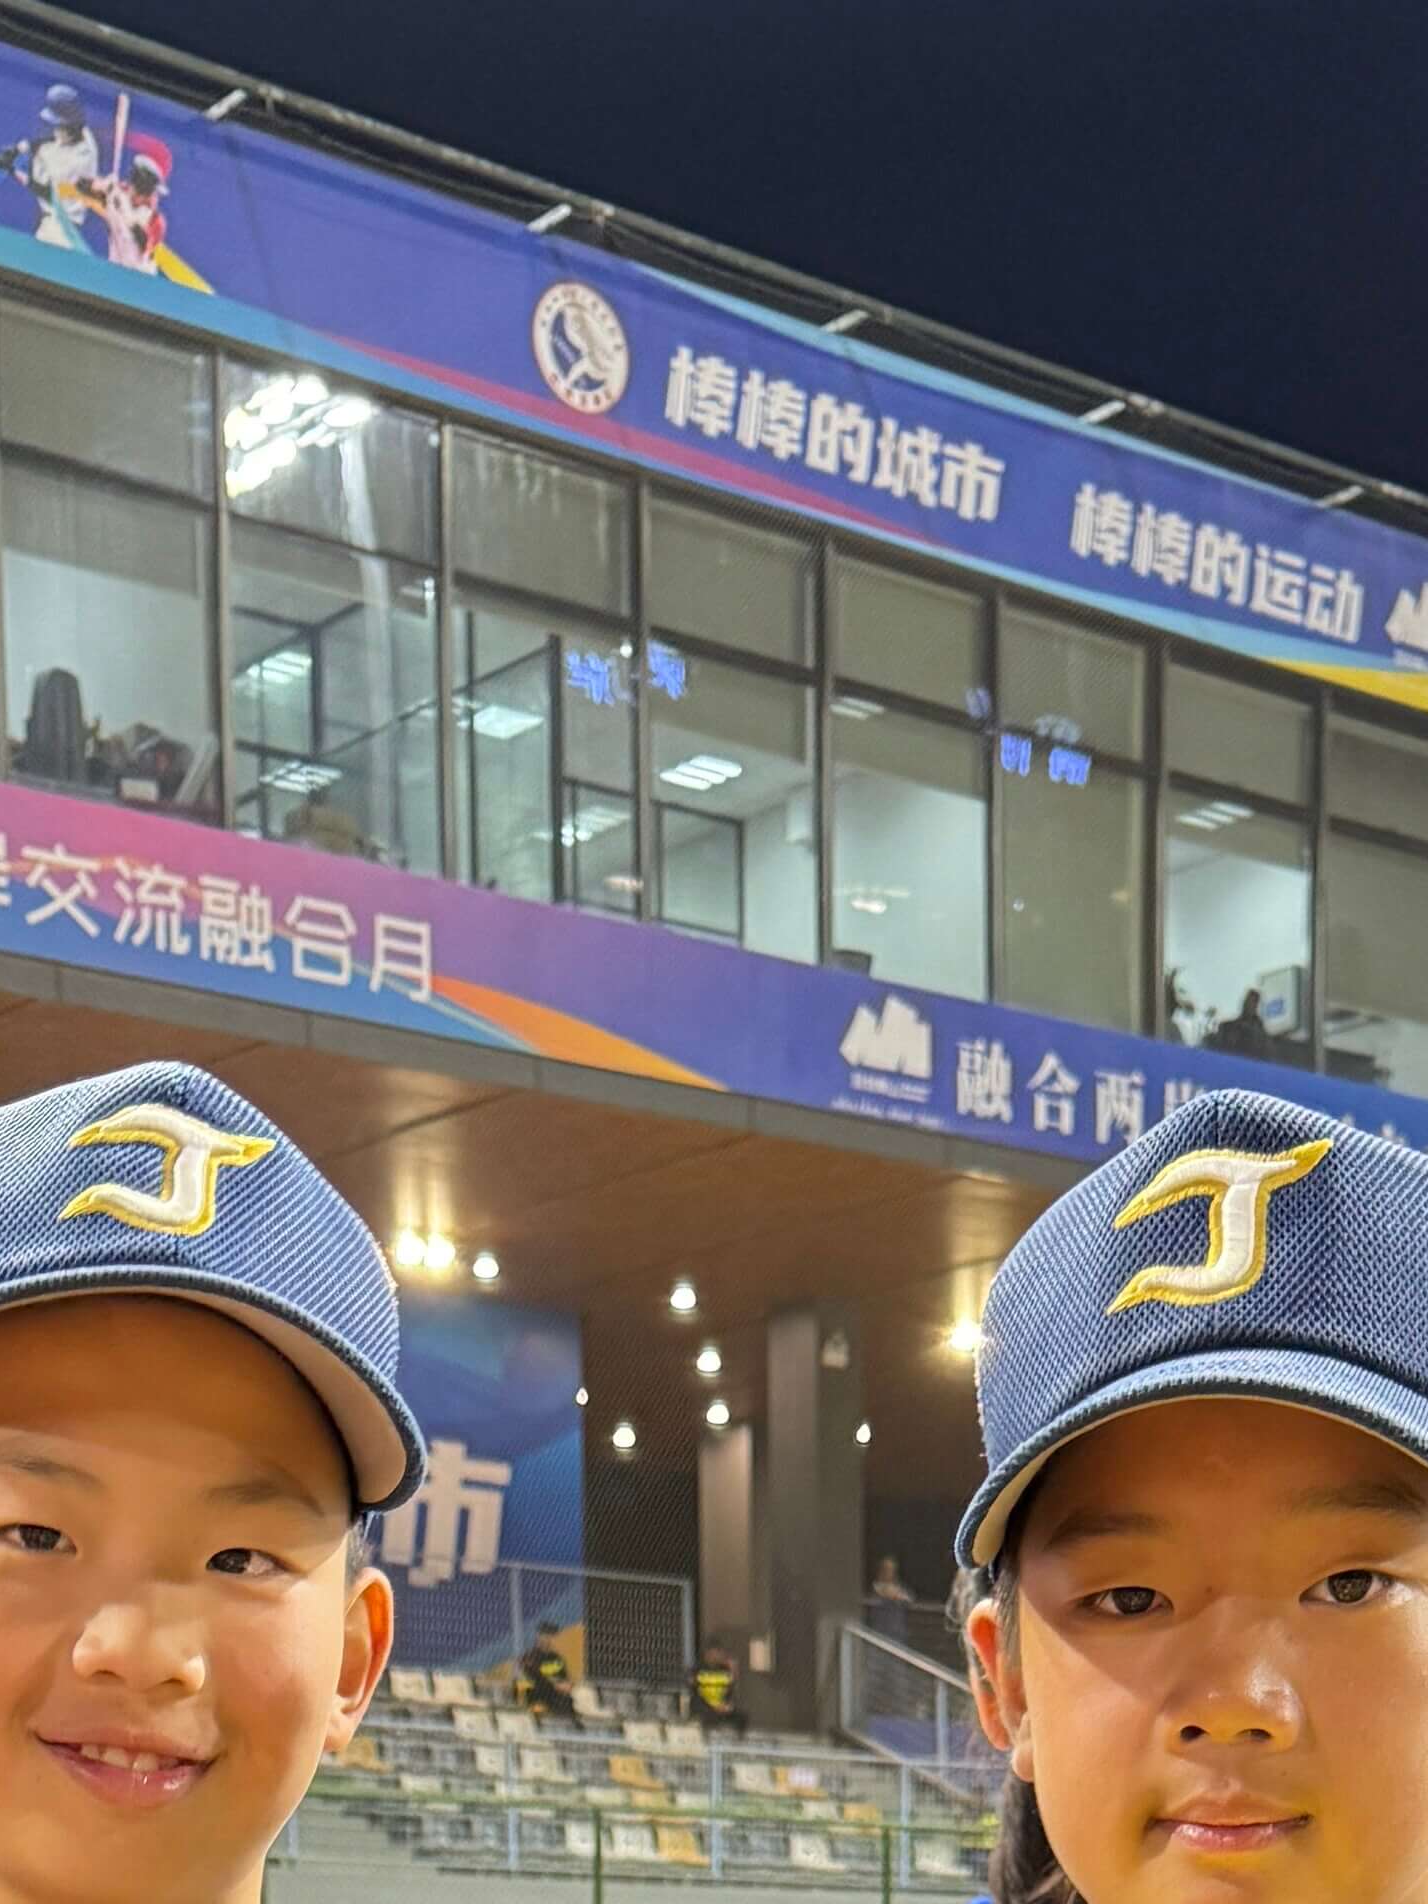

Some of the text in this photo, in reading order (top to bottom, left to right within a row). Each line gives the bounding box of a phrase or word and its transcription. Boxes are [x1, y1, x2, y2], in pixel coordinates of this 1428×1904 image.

[665, 346, 1005, 523] 棒棒的城市
[1069, 482, 1365, 645] 棒棒的运动
